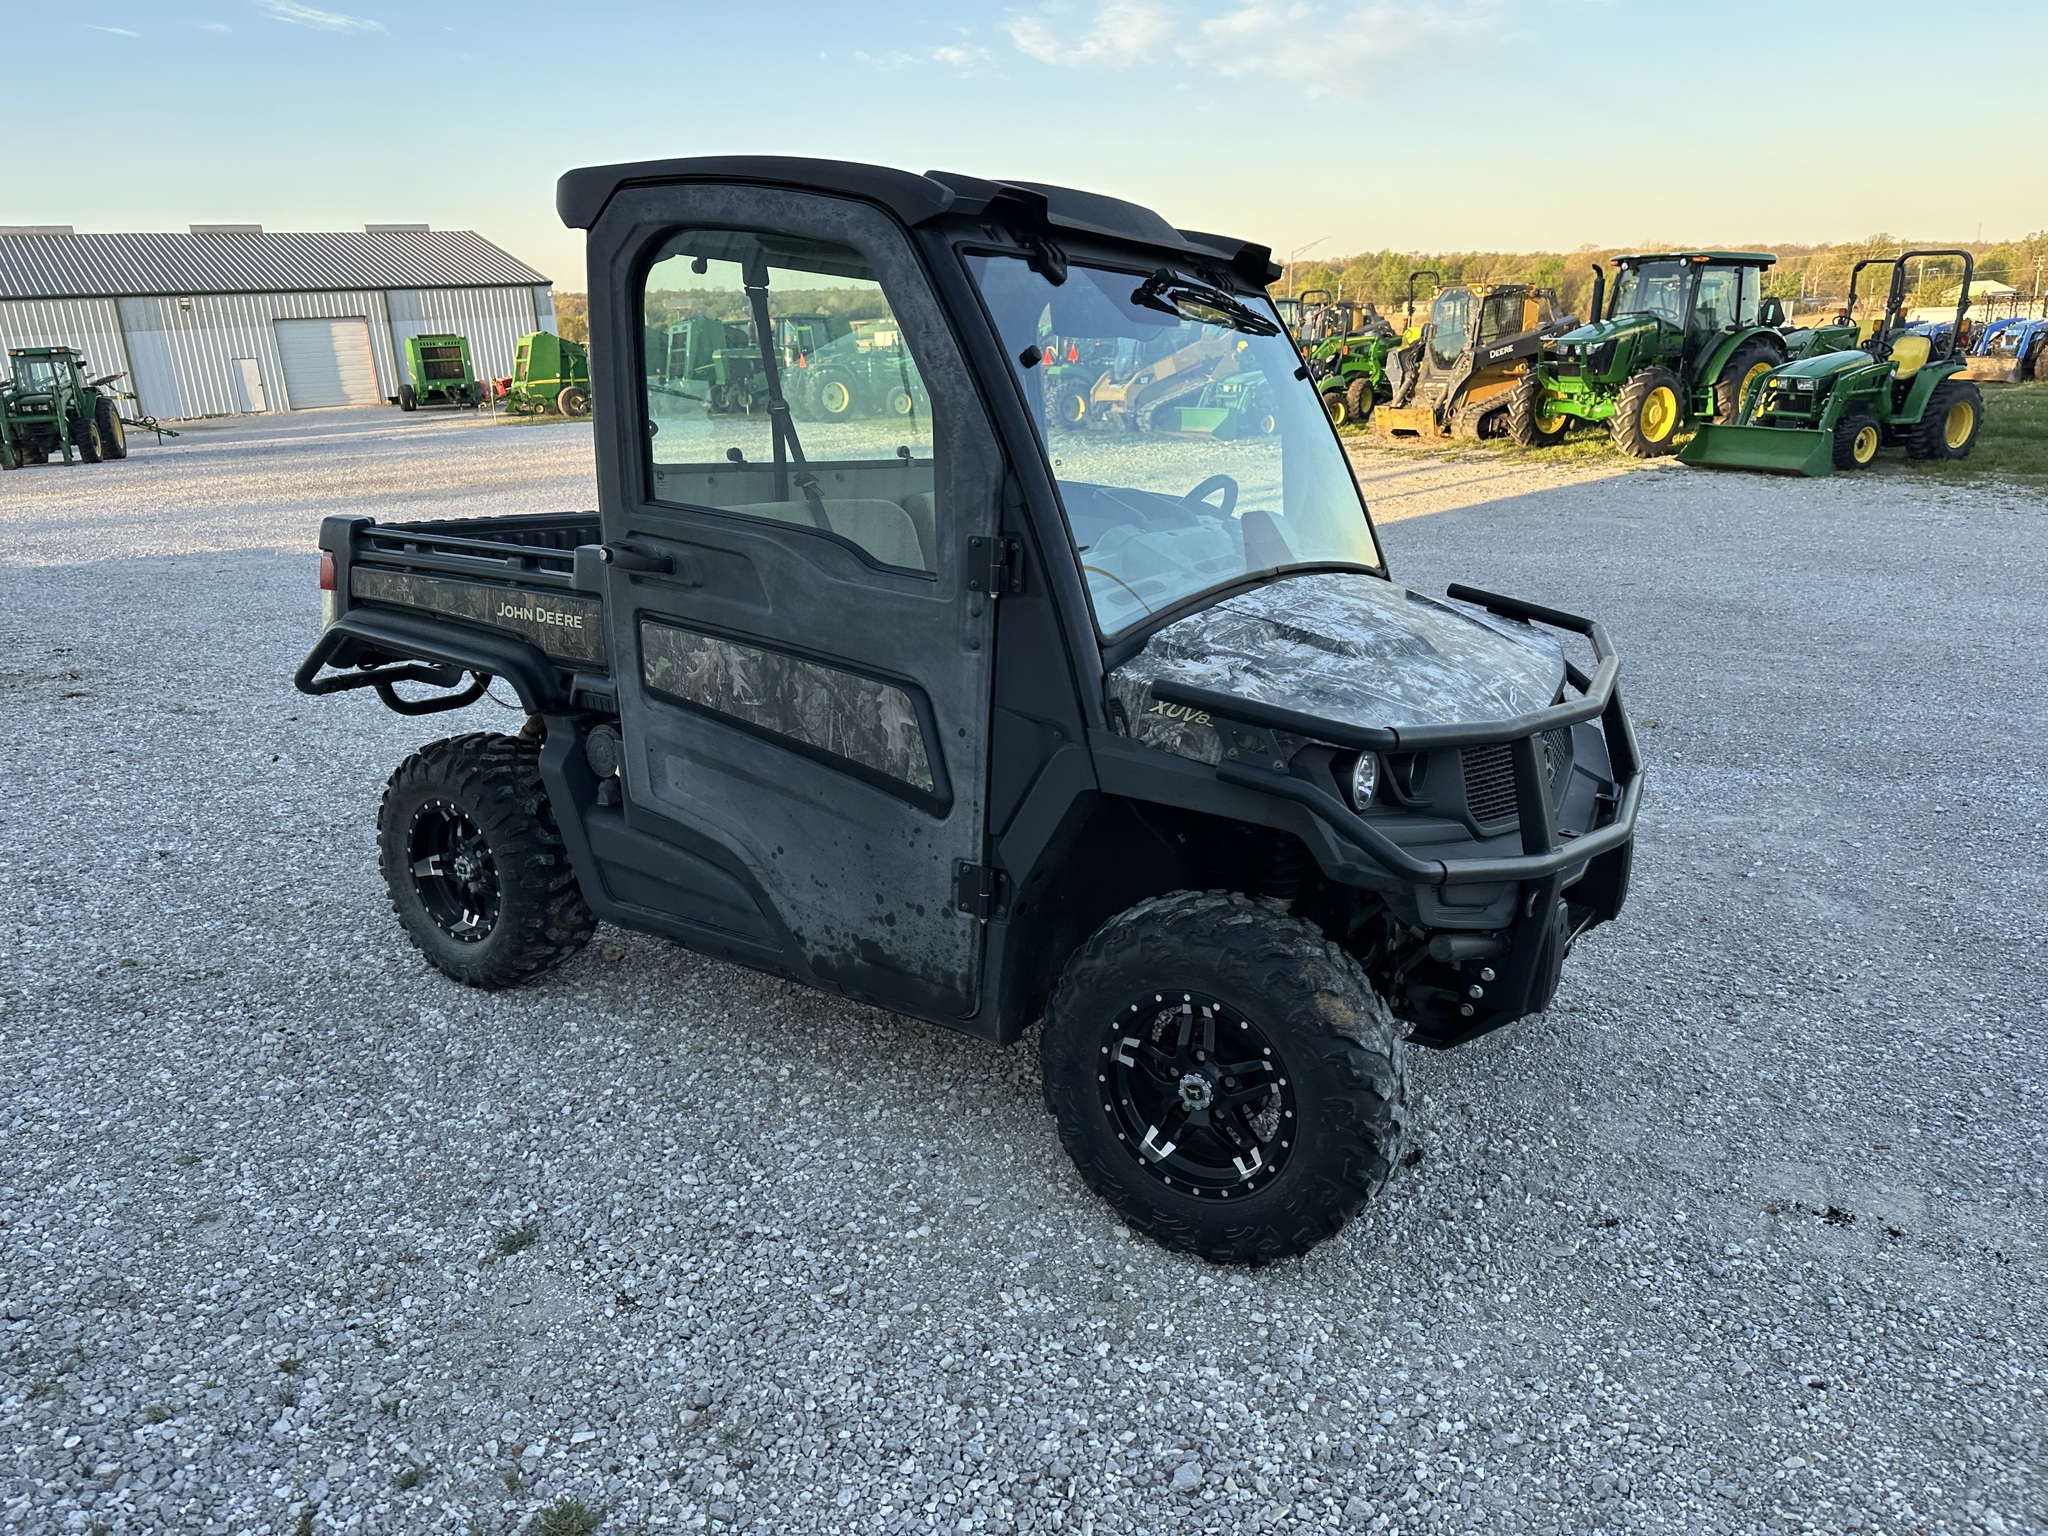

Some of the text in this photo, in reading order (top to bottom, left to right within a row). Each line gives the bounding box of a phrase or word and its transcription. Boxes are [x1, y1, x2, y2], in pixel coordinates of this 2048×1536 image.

[1489, 344, 1514, 359] DEERE
[497, 602, 583, 628] JOHN DEERE
[1149, 700, 1214, 728] XUV8
